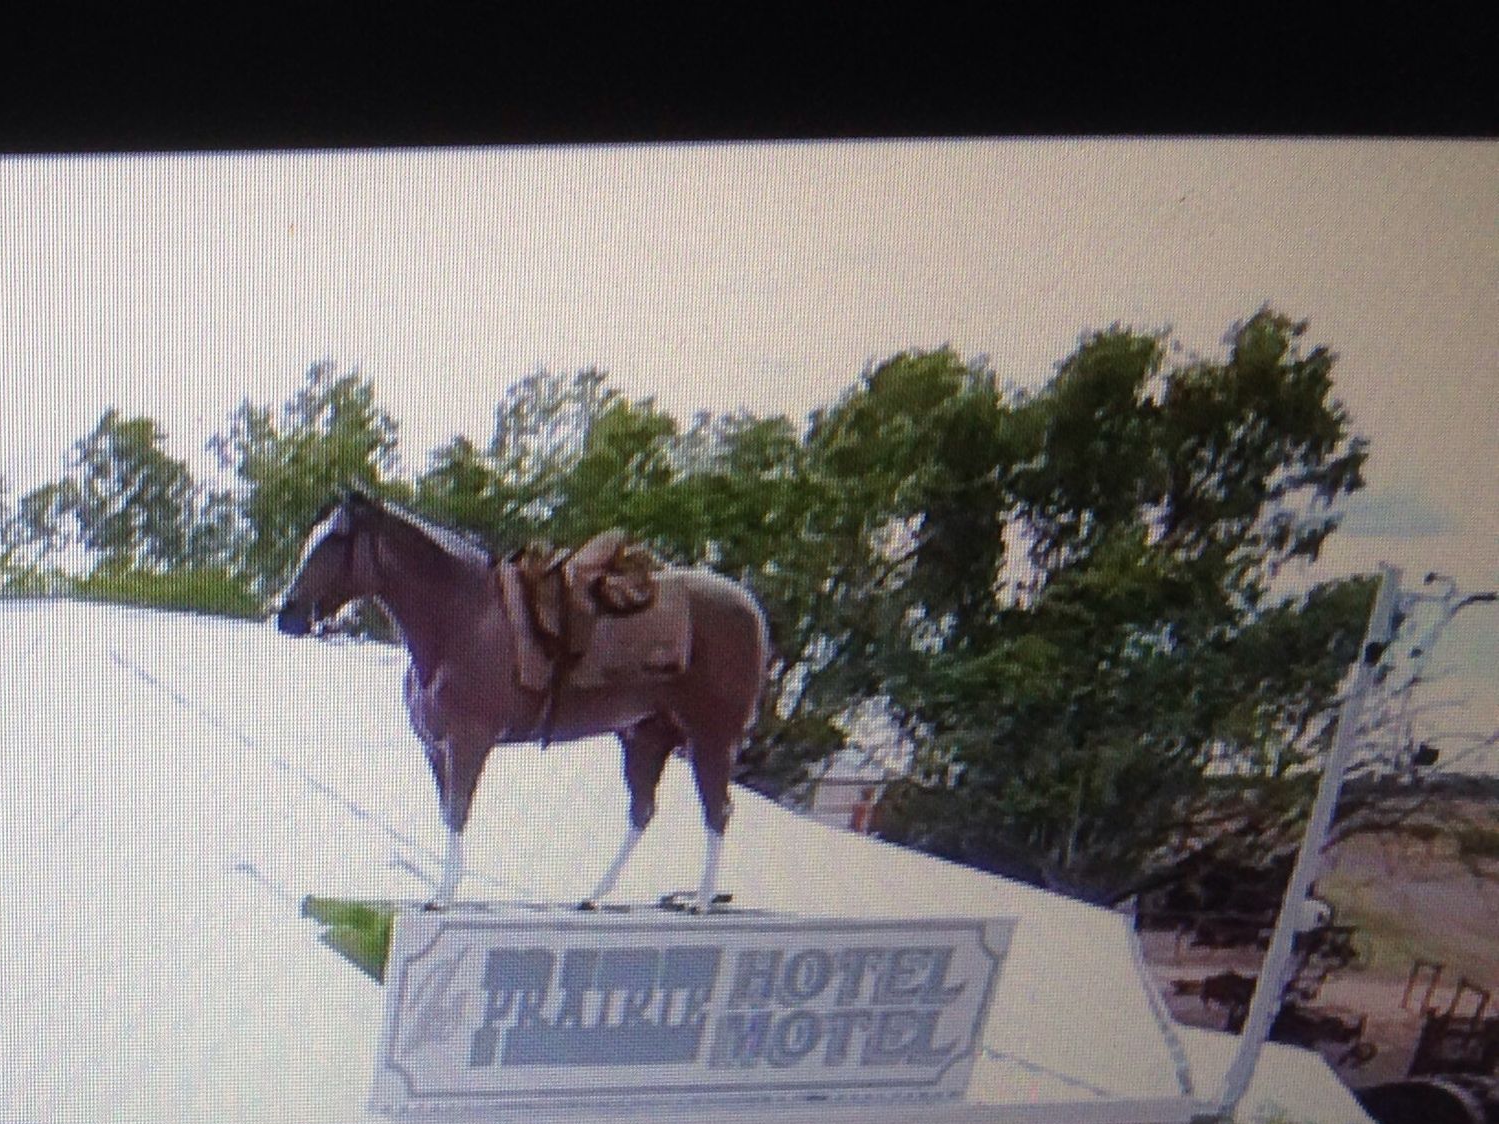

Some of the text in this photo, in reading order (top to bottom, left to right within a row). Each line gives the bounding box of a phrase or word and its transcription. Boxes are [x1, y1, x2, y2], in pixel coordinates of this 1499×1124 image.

[724, 944, 966, 1004] HOTEL
[469, 945, 722, 1068] PRAIRIE
[706, 1009, 959, 1070] MOTEL
